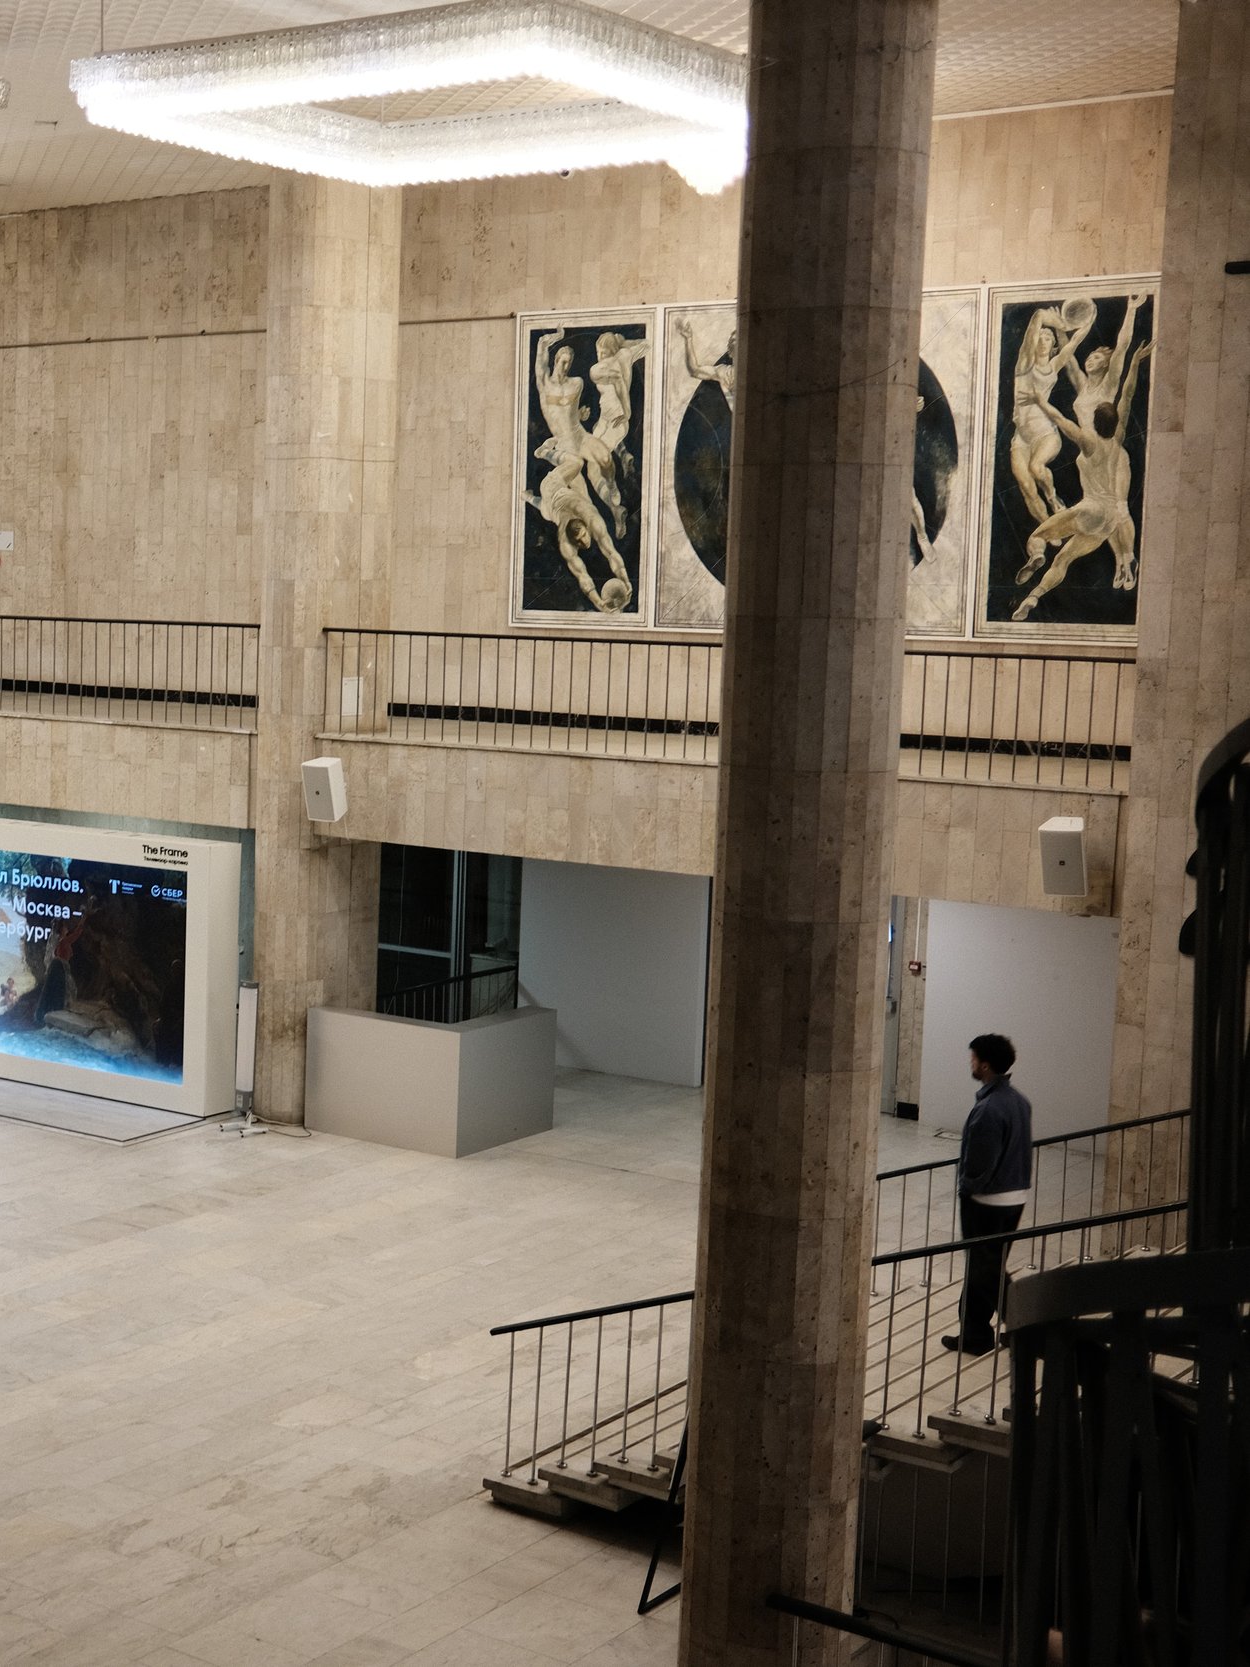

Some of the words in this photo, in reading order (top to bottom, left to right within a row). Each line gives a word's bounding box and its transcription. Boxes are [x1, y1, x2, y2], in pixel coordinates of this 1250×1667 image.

[142, 844, 158, 854] The
[160, 847, 188, 858] Frame
[12, 868, 84, 894] Брюллов.
[161, 887, 183, 898] СБЕР
[13, 895, 71, 919] Москва
